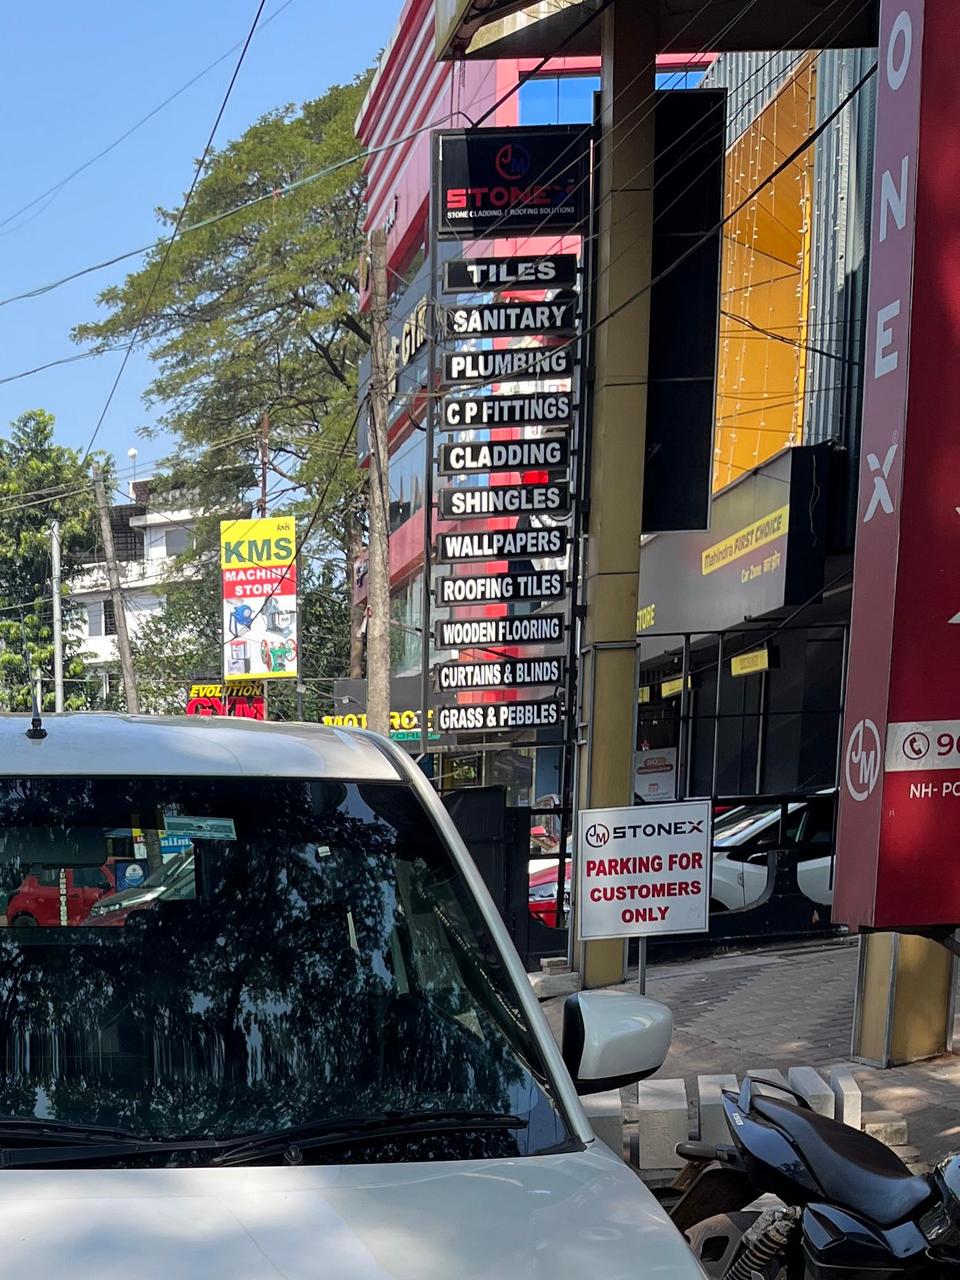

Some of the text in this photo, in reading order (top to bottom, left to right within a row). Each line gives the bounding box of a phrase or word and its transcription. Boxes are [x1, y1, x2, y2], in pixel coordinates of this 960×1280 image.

[467, 262, 556, 283] TILES
[453, 305, 566, 332] SANITARY
[451, 351, 567, 378] PLUMBING
[482, 396, 569, 422] FITTINGS
[450, 442, 561, 469] CLADDING
[452, 487, 560, 514] SHINGLES
[446, 530, 561, 557] WALLPAPERS
[734, 529, 755, 554] FIRST
[755, 513, 783, 543] CHOICE
[224, 537, 293, 563] KMS
[225, 567, 290, 582] MACHINE
[235, 583, 282, 596] STORE
[444, 575, 561, 600] ROOFING TILES
[443, 618, 559, 644] WOODEN FLOORING
[441, 661, 559, 687] CURTAINS & BLINDS
[189, 685, 261, 698] EVOLUTION
[186, 698, 264, 720] GYM
[440, 703, 557, 730] GRASS & PEBBLES
[937, 733, 960, 756] 9
[910, 783, 938, 798] NH-
[613, 820, 704, 839] STONEX
[586, 852, 703, 877] PARKING FOR
[590, 880, 702, 902] CUSTOMERS
[621, 906, 670, 923] ONLY
